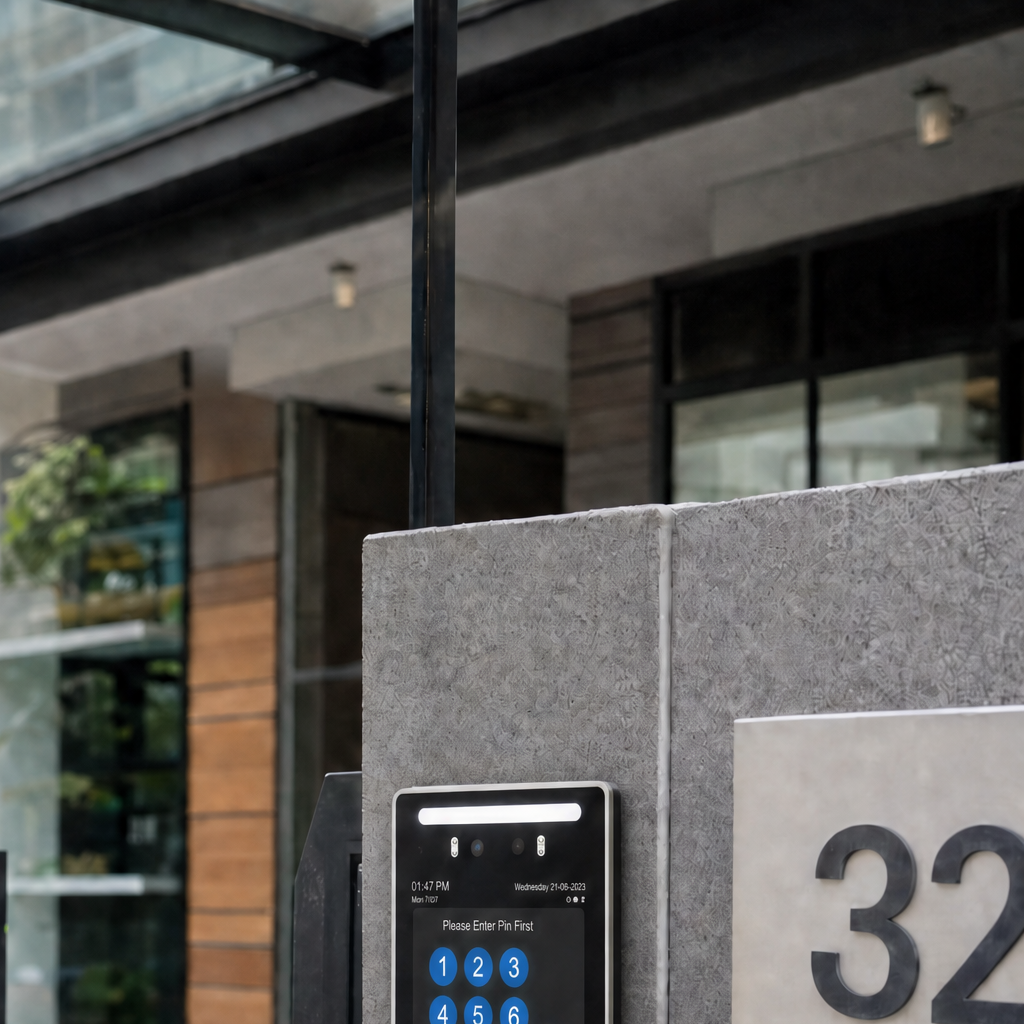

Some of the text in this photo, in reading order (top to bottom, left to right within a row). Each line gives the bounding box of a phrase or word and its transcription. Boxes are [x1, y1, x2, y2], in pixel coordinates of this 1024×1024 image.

[411, 881, 450, 891] 01:47 PM
[514, 882, 549, 893] Wednesday
[442, 920, 534, 932] Please Enter Pin First
[438, 955, 520, 978] 1 2 3
[437, 1004, 449, 1024] 4
